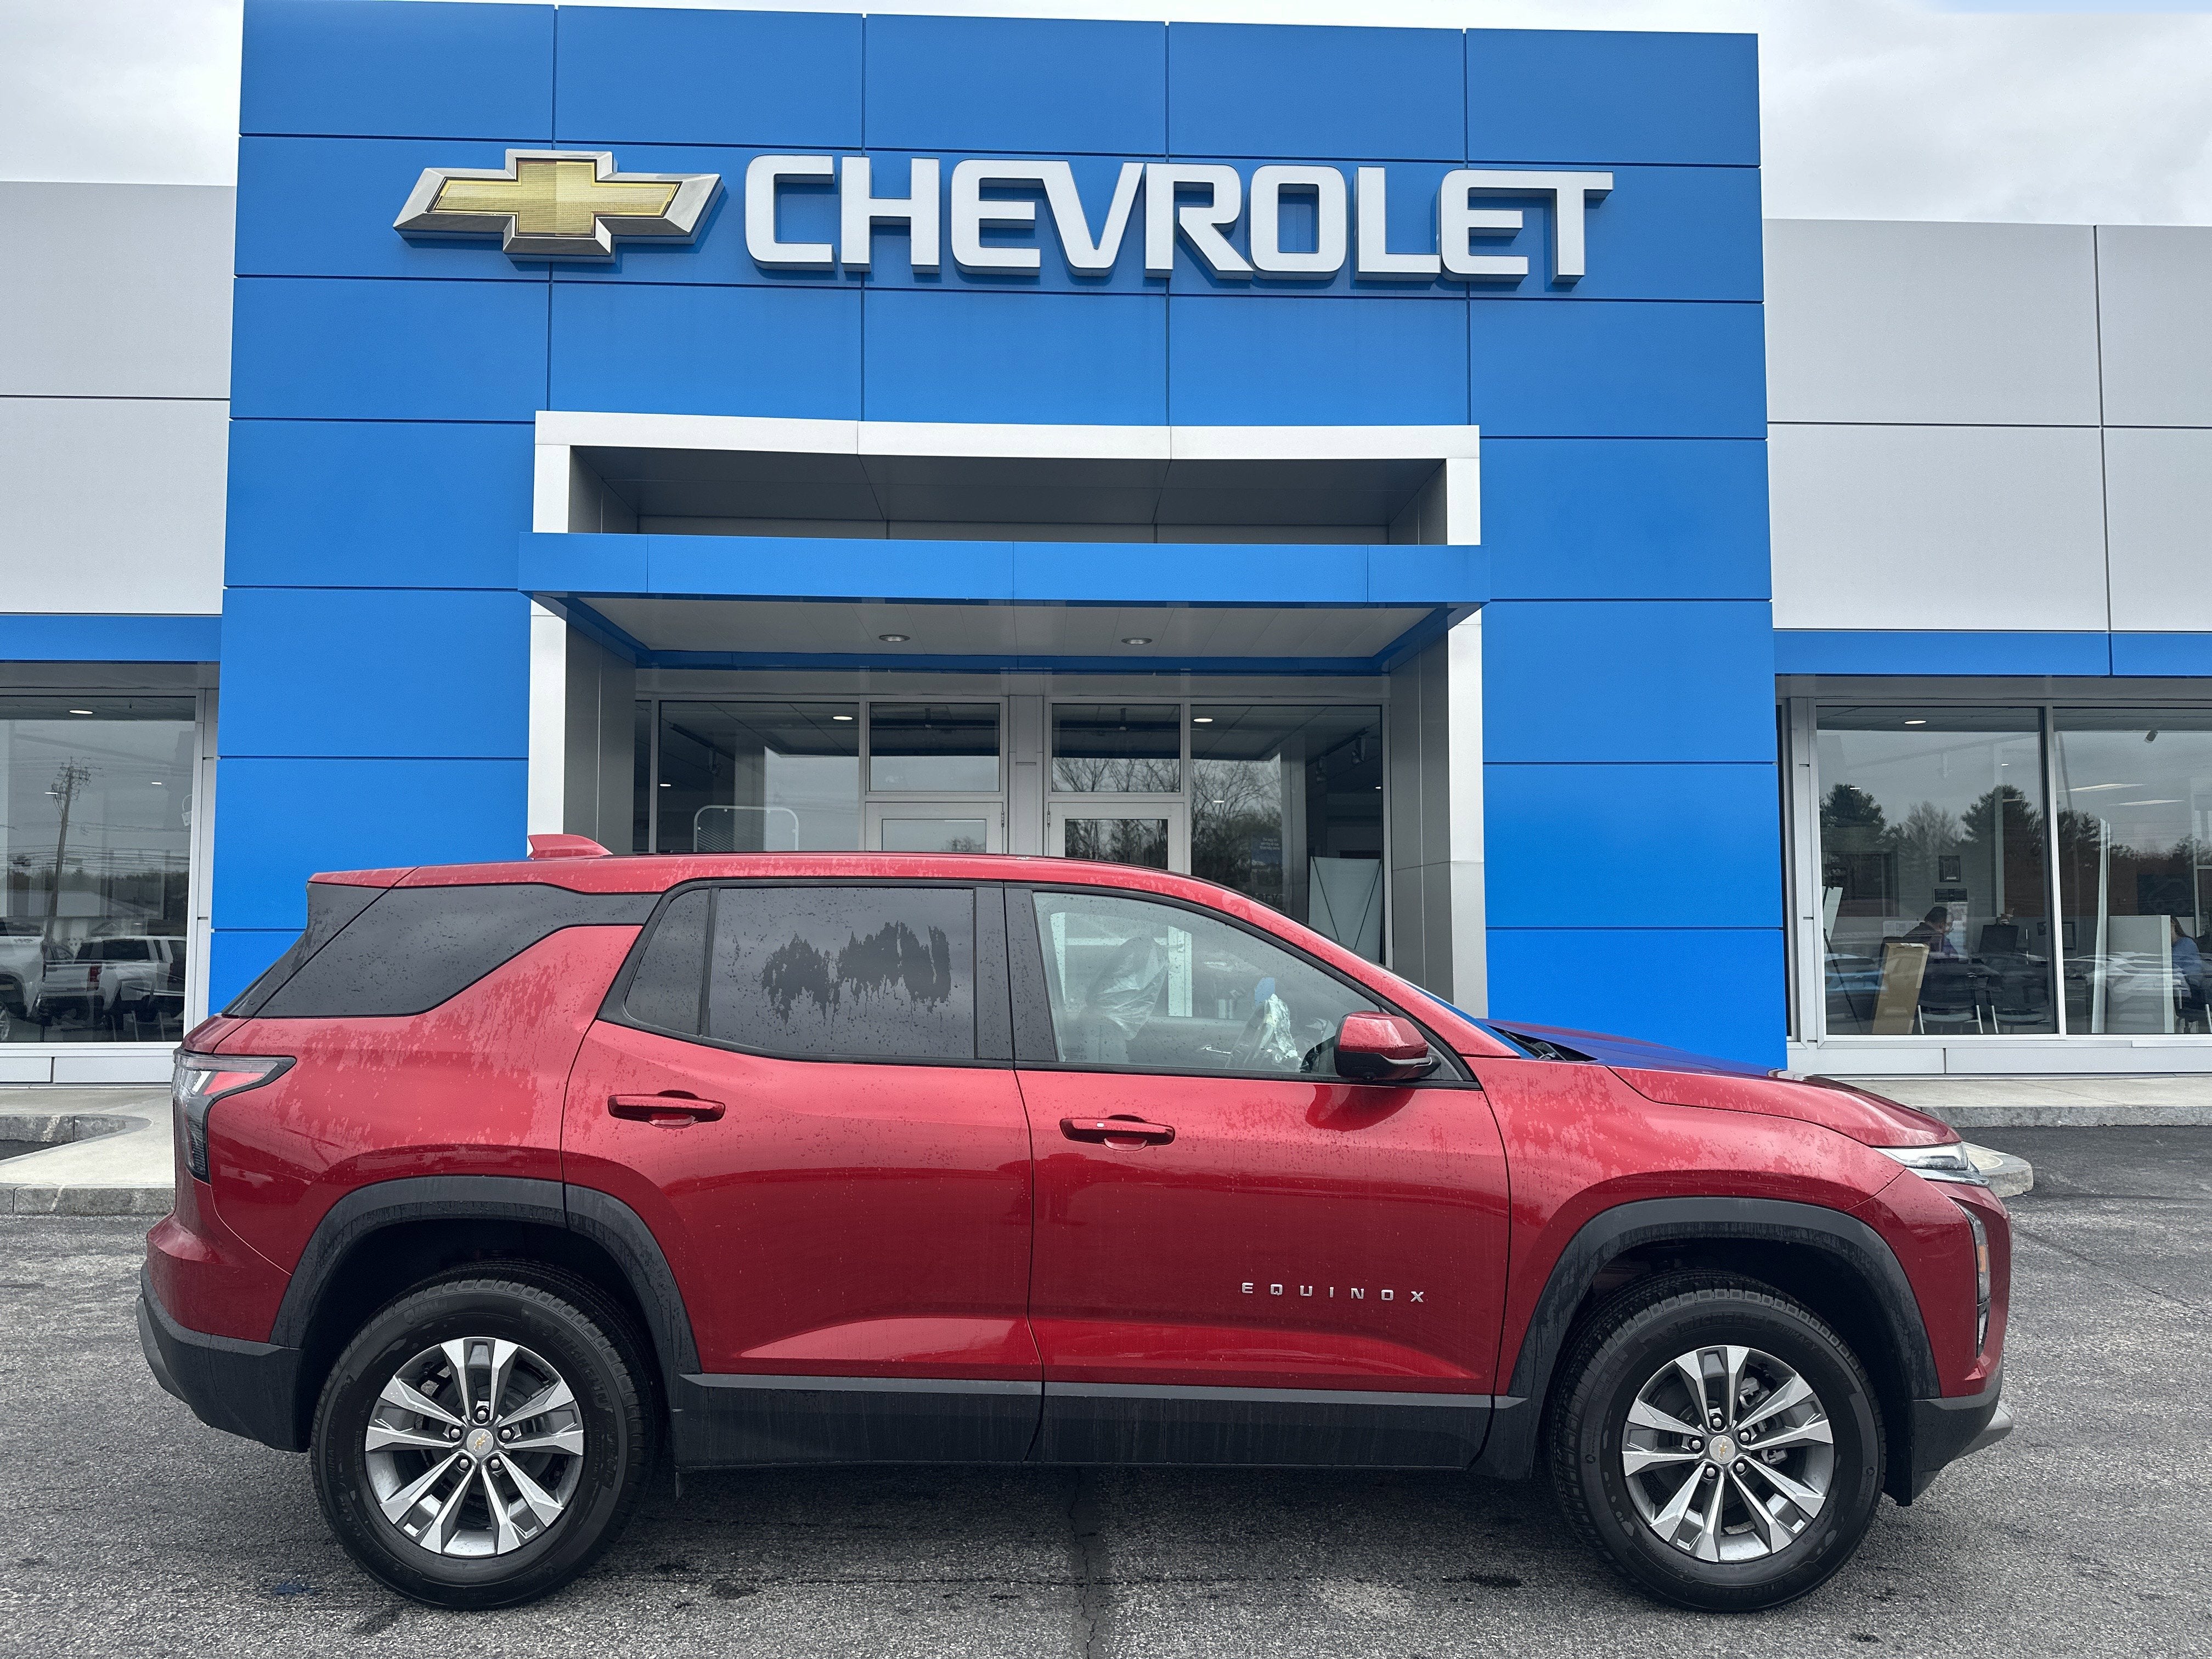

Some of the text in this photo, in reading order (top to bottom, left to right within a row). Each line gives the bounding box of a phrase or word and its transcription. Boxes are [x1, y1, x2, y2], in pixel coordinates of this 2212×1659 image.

[744, 154, 1614, 282] CHEVROLET
[1242, 1282, 1424, 1303] EQUINOX
[1775, 1323, 1819, 1351] PRIMACY
